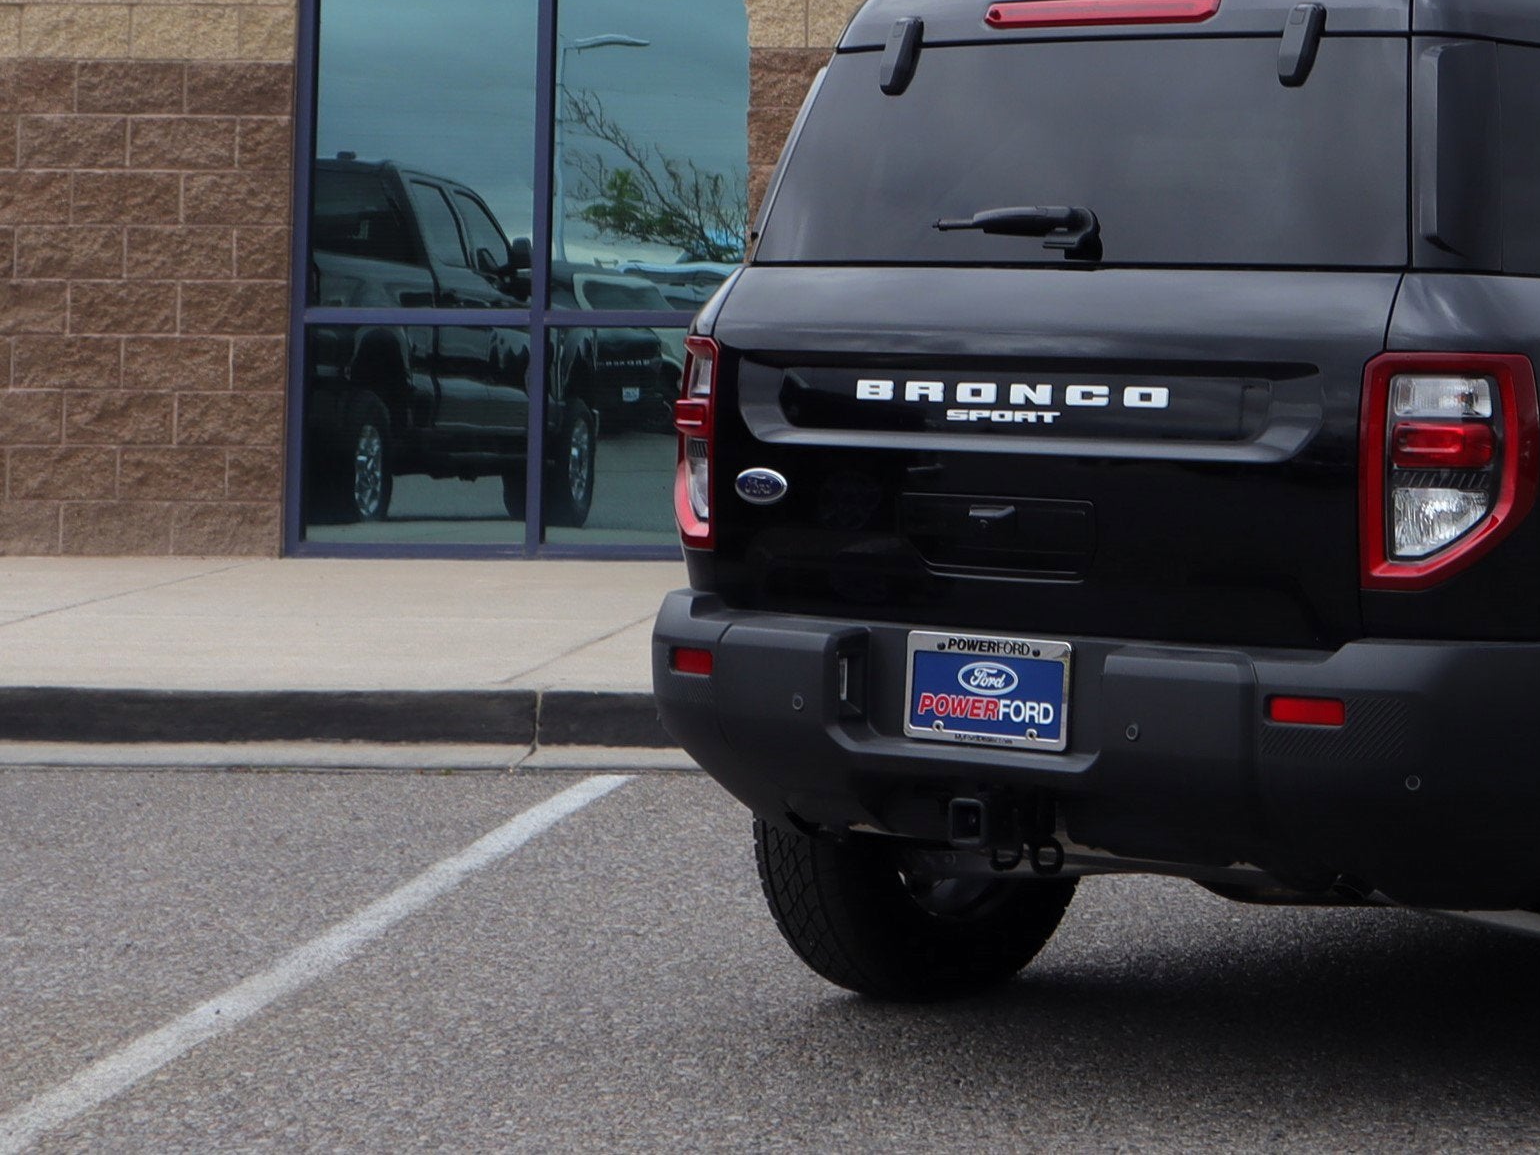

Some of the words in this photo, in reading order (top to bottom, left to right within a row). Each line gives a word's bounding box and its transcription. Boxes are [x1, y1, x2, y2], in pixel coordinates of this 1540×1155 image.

[856, 379, 1169, 408] BRONCO
[946, 409, 1061, 423] SPORT
[969, 667, 1006, 688] Ford
